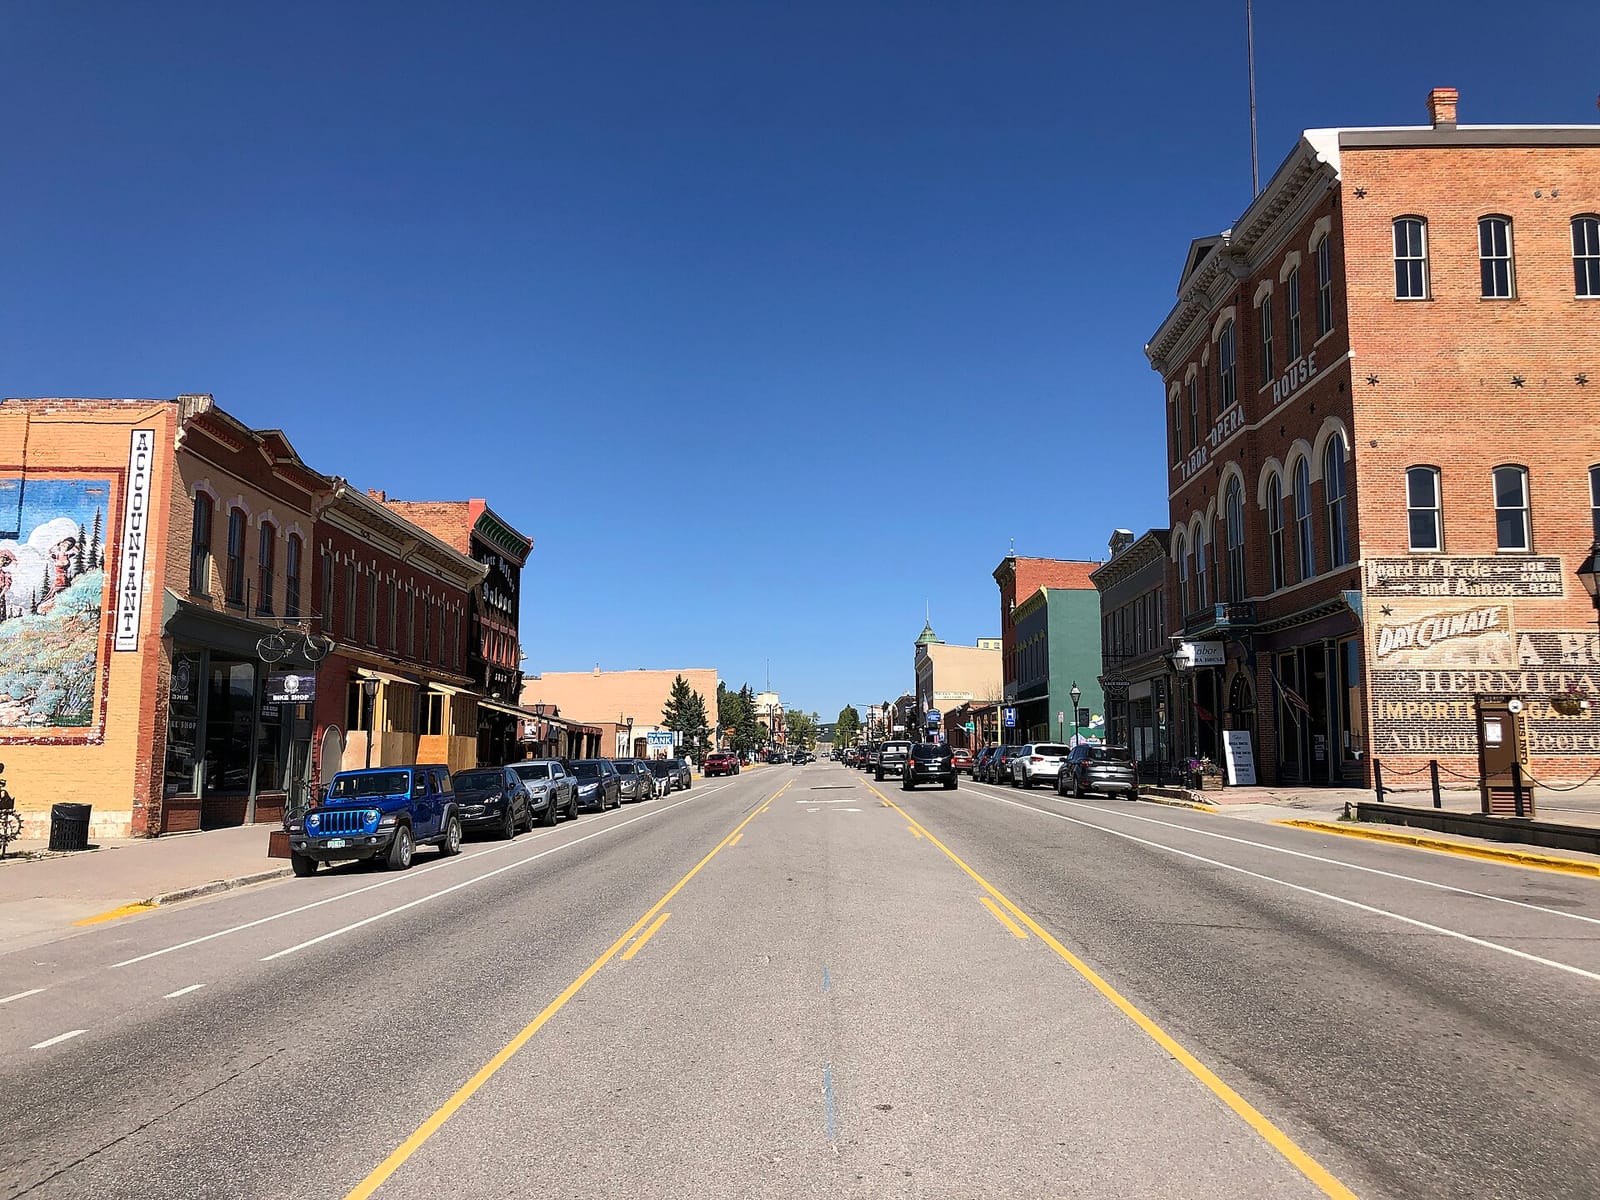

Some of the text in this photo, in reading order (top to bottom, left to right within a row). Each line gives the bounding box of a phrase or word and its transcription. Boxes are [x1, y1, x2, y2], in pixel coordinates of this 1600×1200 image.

[1181, 350, 1318, 481] TABOR OPERA HOUSE
[123, 432, 148, 632] ACCOUNTANT
[1367, 560, 1491, 587] Board of Trade
[1520, 562, 1546, 571] JOE
[1520, 572, 1559, 582] GAVIN
[1419, 578, 1449, 595] and
[1192, 644, 1217, 655] Tabor
[1006, 708, 1014, 719] H
[1377, 700, 1476, 720] IMPORTE
[648, 737, 671, 745] BANK
[1518, 716, 1528, 765] BUS INFO
